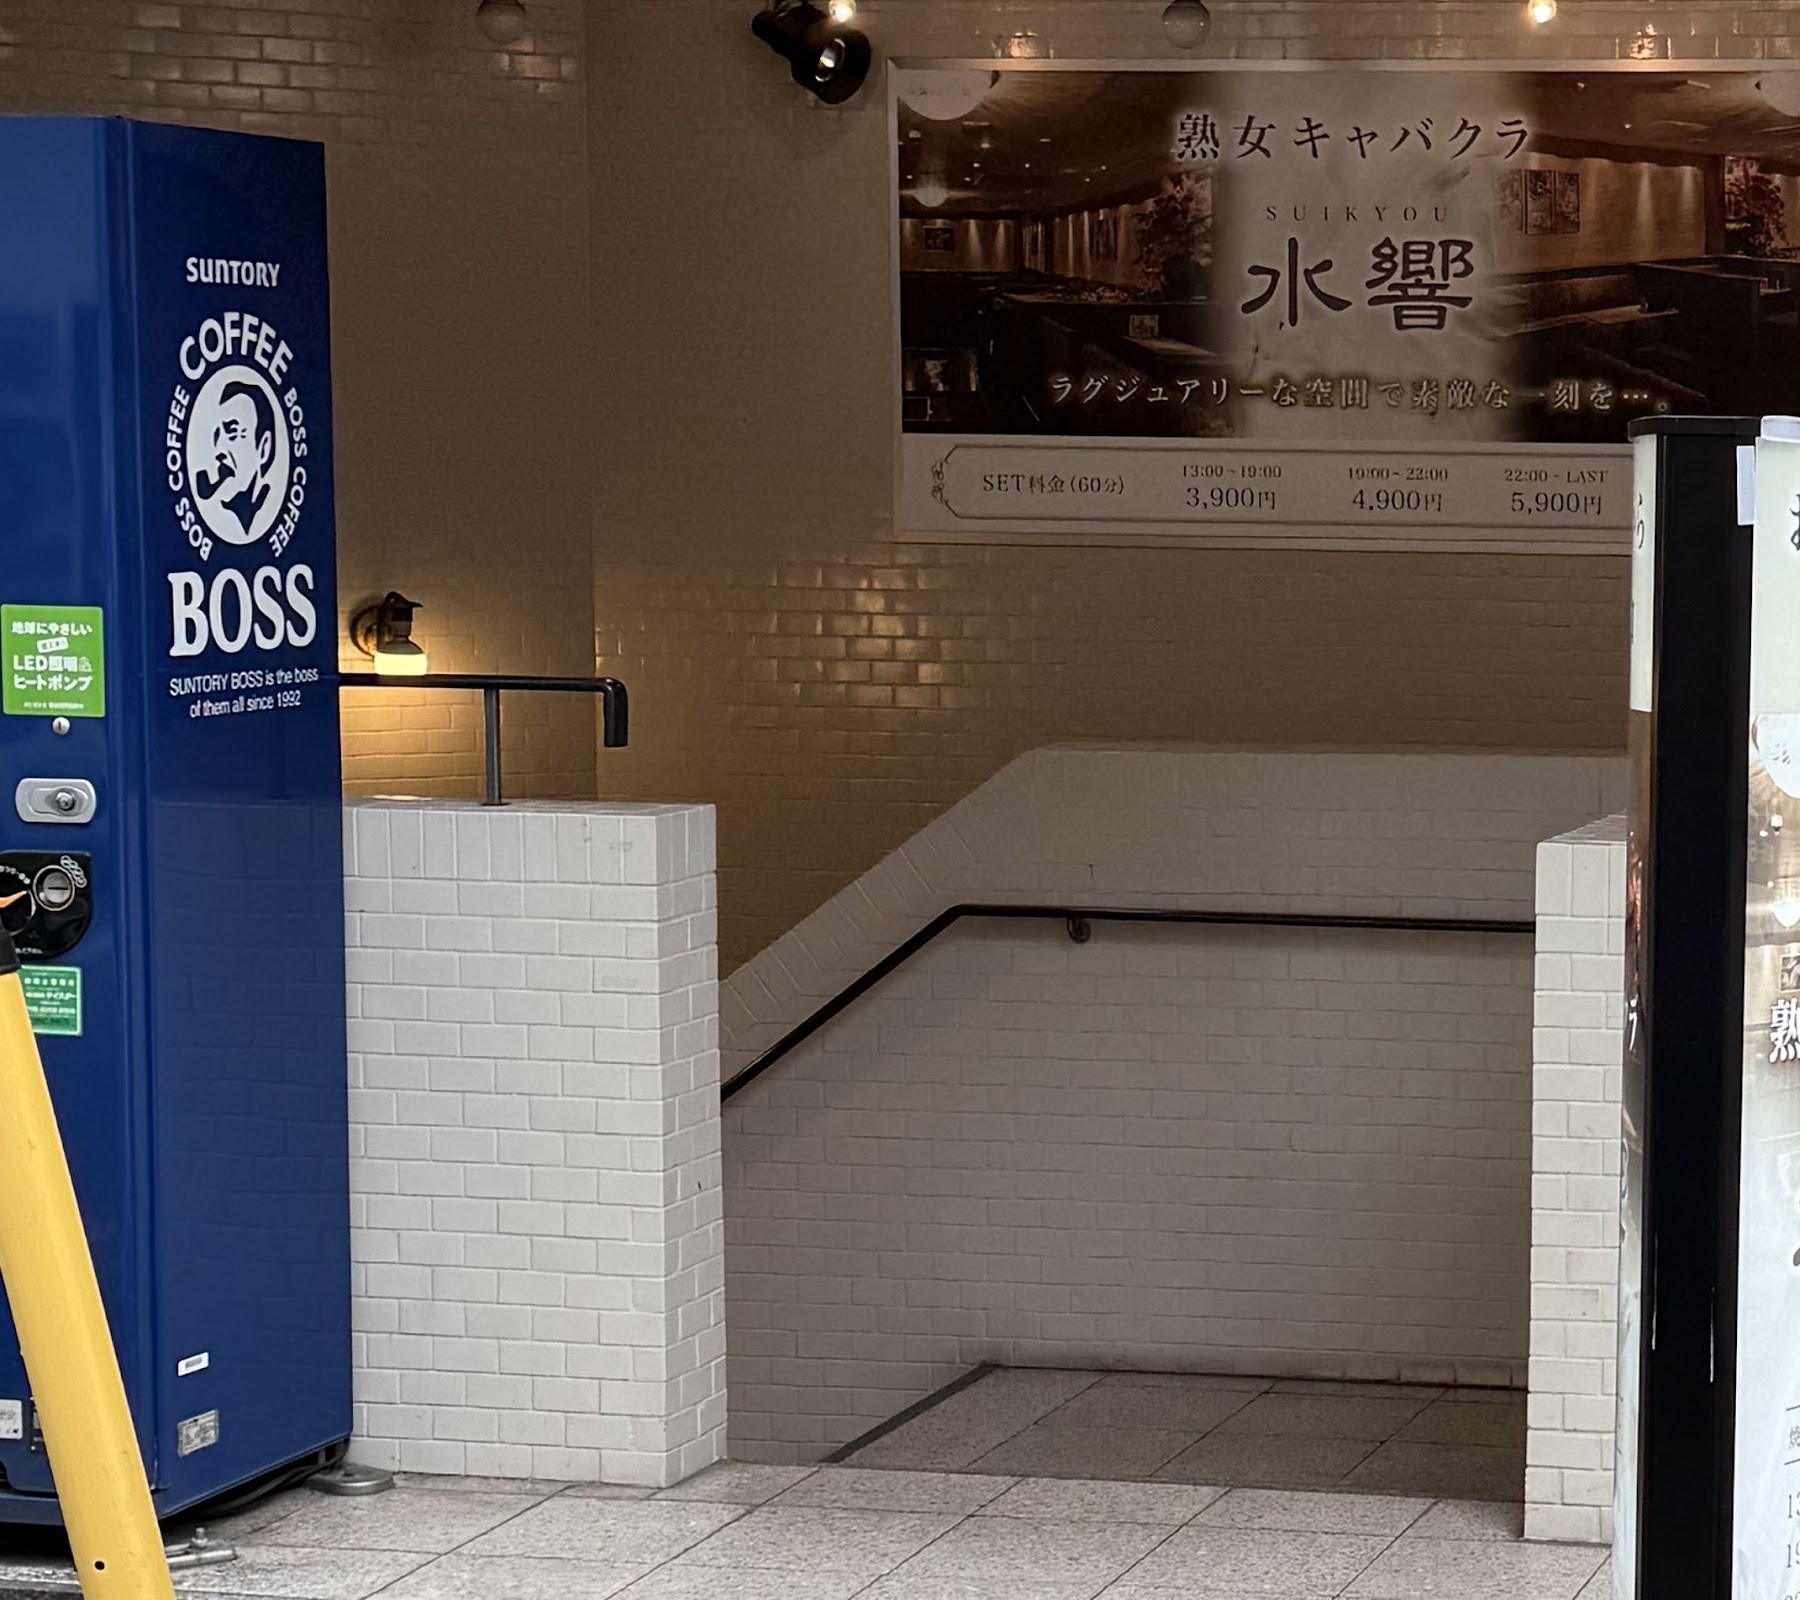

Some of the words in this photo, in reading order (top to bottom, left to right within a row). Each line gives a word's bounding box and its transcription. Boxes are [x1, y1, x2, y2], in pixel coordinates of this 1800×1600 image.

[1177, 114, 1529, 160] 熟女キャバクラ
[1266, 205, 1449, 222] SUIKYOU
[186, 257, 280, 287] SUNTORY
[1240, 237, 1474, 331] 水響
[179, 311, 294, 385] COFFEE
[166, 385, 190, 491] COFFEE
[284, 387, 308, 457] BOSS
[269, 466, 306, 557] COFFEE
[1186, 487, 1276, 510] 3,900円
[1511, 491, 1601, 515] 5,900円
[175, 497, 213, 561] BOSS
[167, 564, 316, 657] BOSS
[13, 674, 93, 691] ヒートポンプ
[169, 673, 228, 696] SUNTORY
[231, 670, 263, 689] BOSS
[265, 670, 274, 685] is
[276, 669, 293, 684] the
[295, 668, 319, 683] boss
[190, 700, 200, 718] of
[203, 699, 230, 716] them
[232, 696, 244, 712] all
[247, 695, 274, 711] since
[277, 690, 301, 707] 1992
